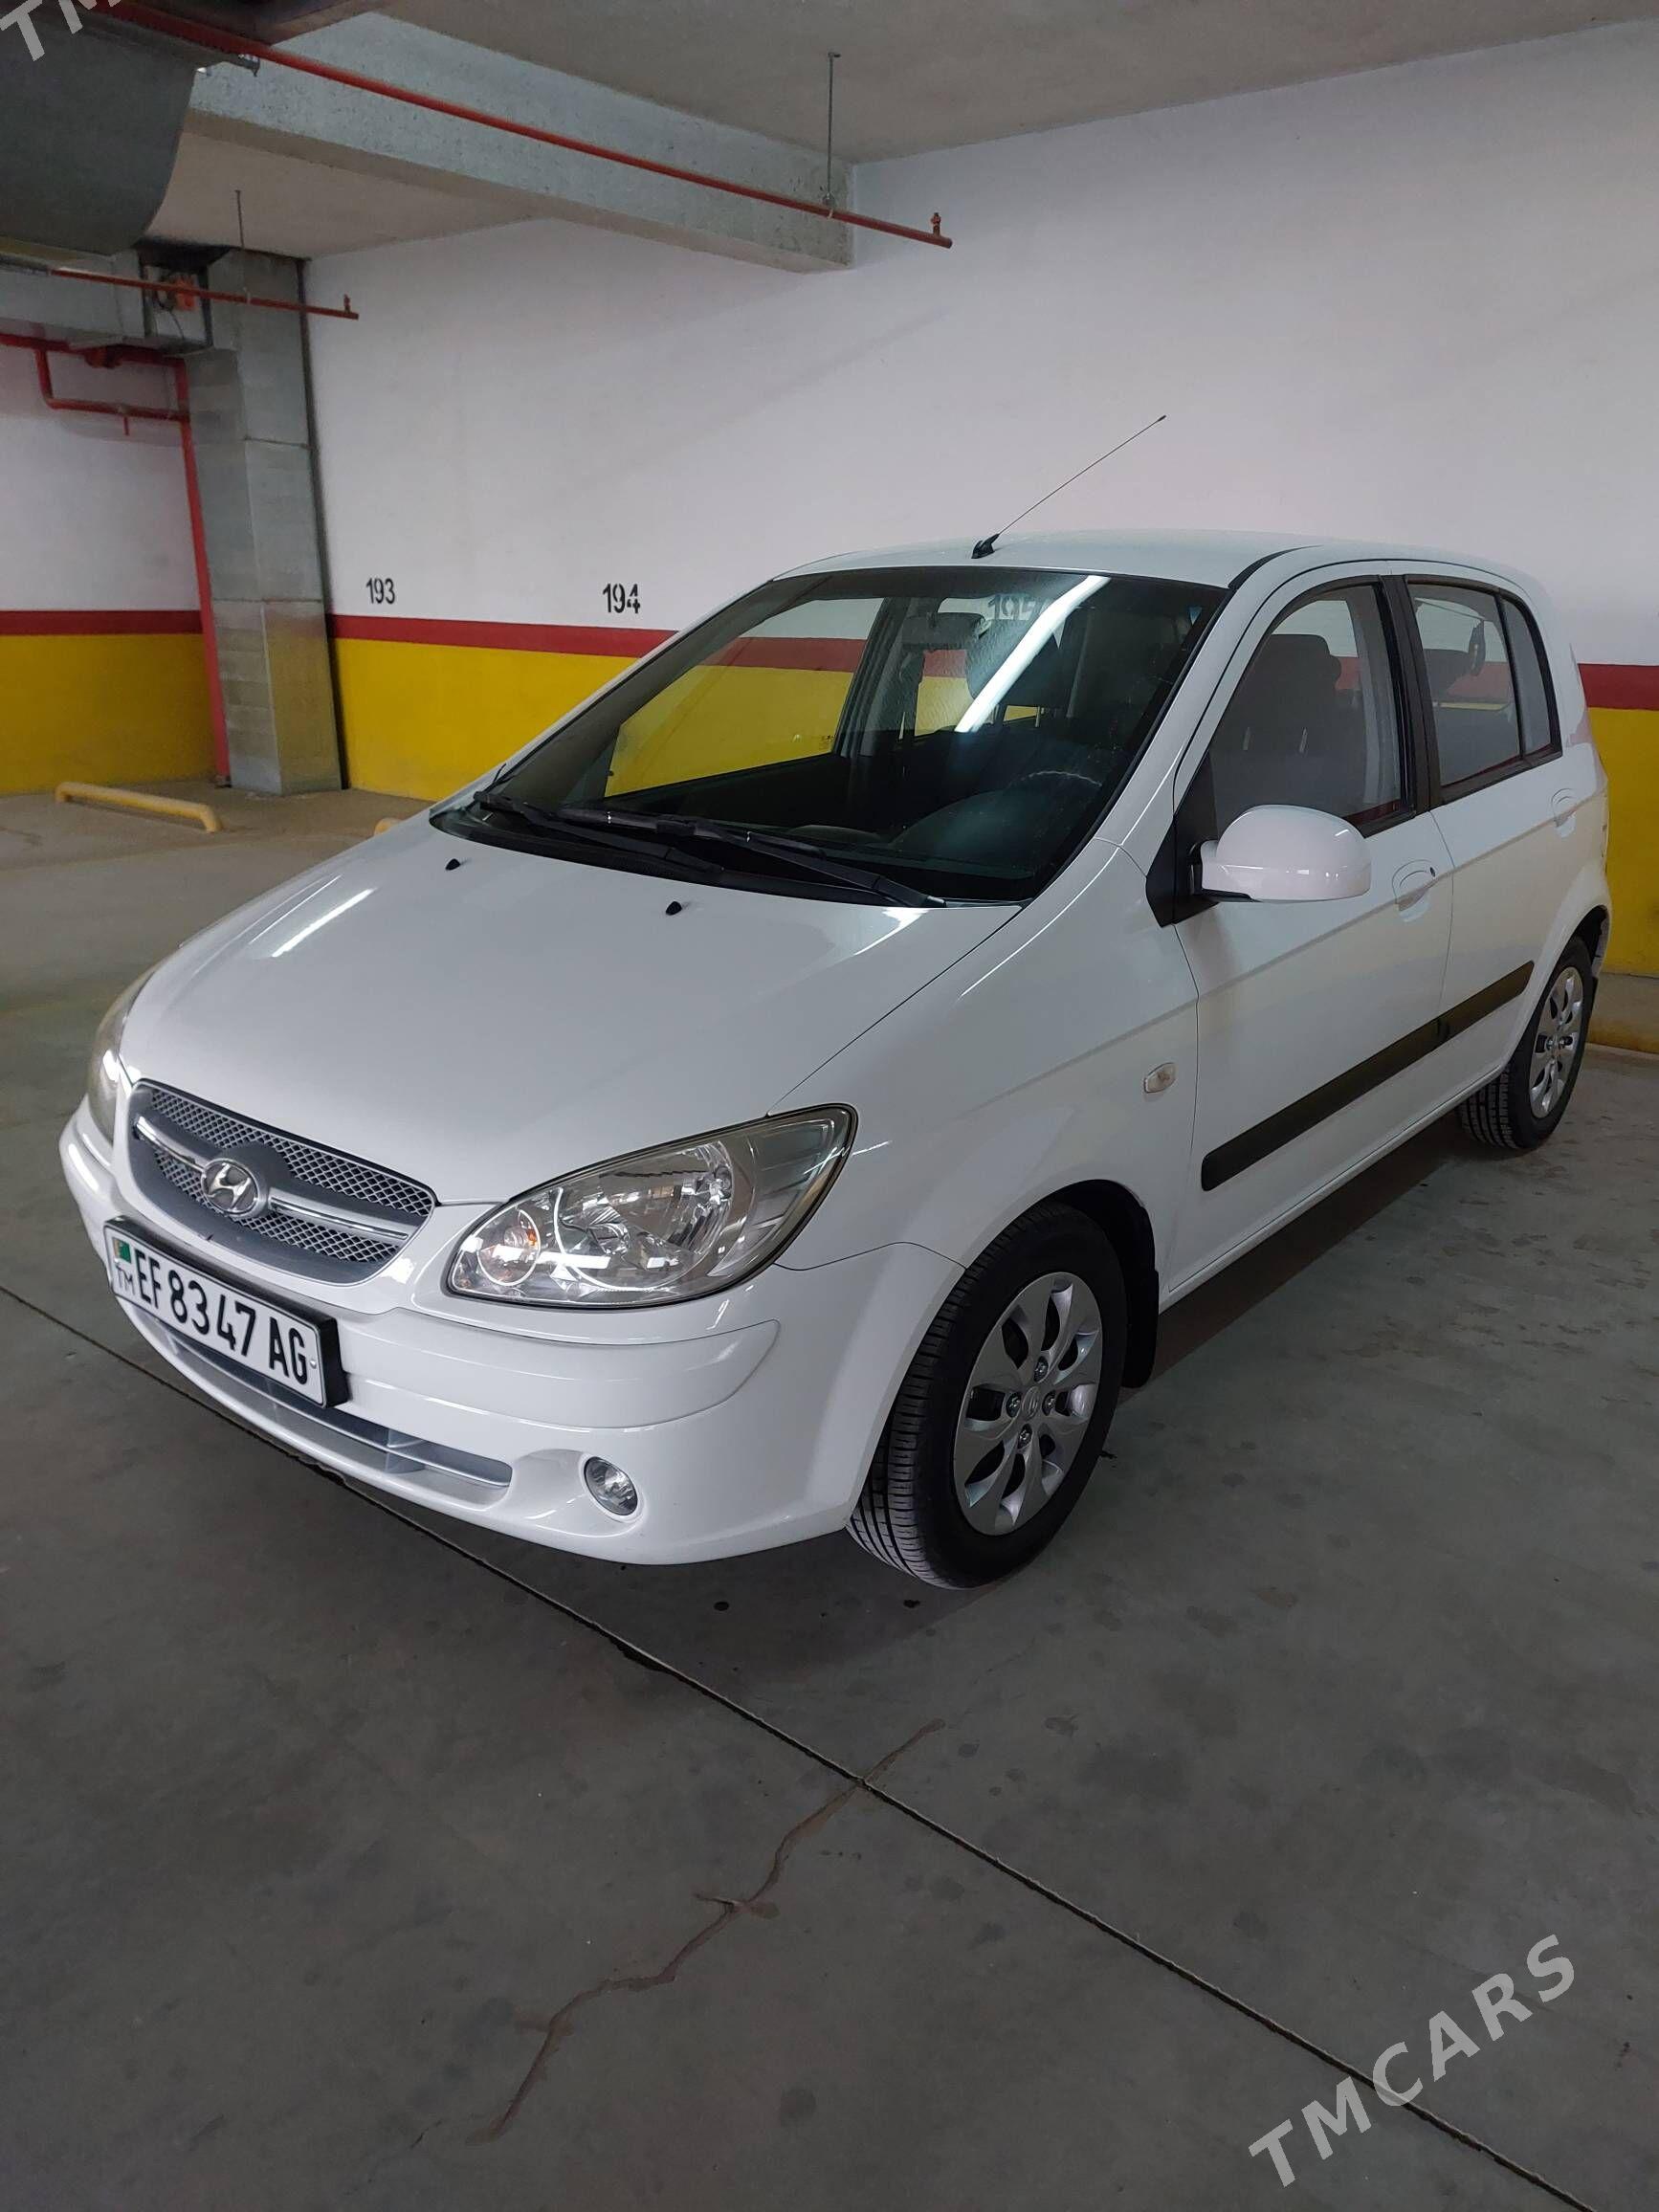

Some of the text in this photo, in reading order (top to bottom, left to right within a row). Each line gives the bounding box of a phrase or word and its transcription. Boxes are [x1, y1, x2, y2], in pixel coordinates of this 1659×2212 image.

[366, 578, 396, 604] 193
[603, 583, 641, 613] 194
[116, 1263, 135, 1295] TM
[269, 1316, 308, 1385] AG
